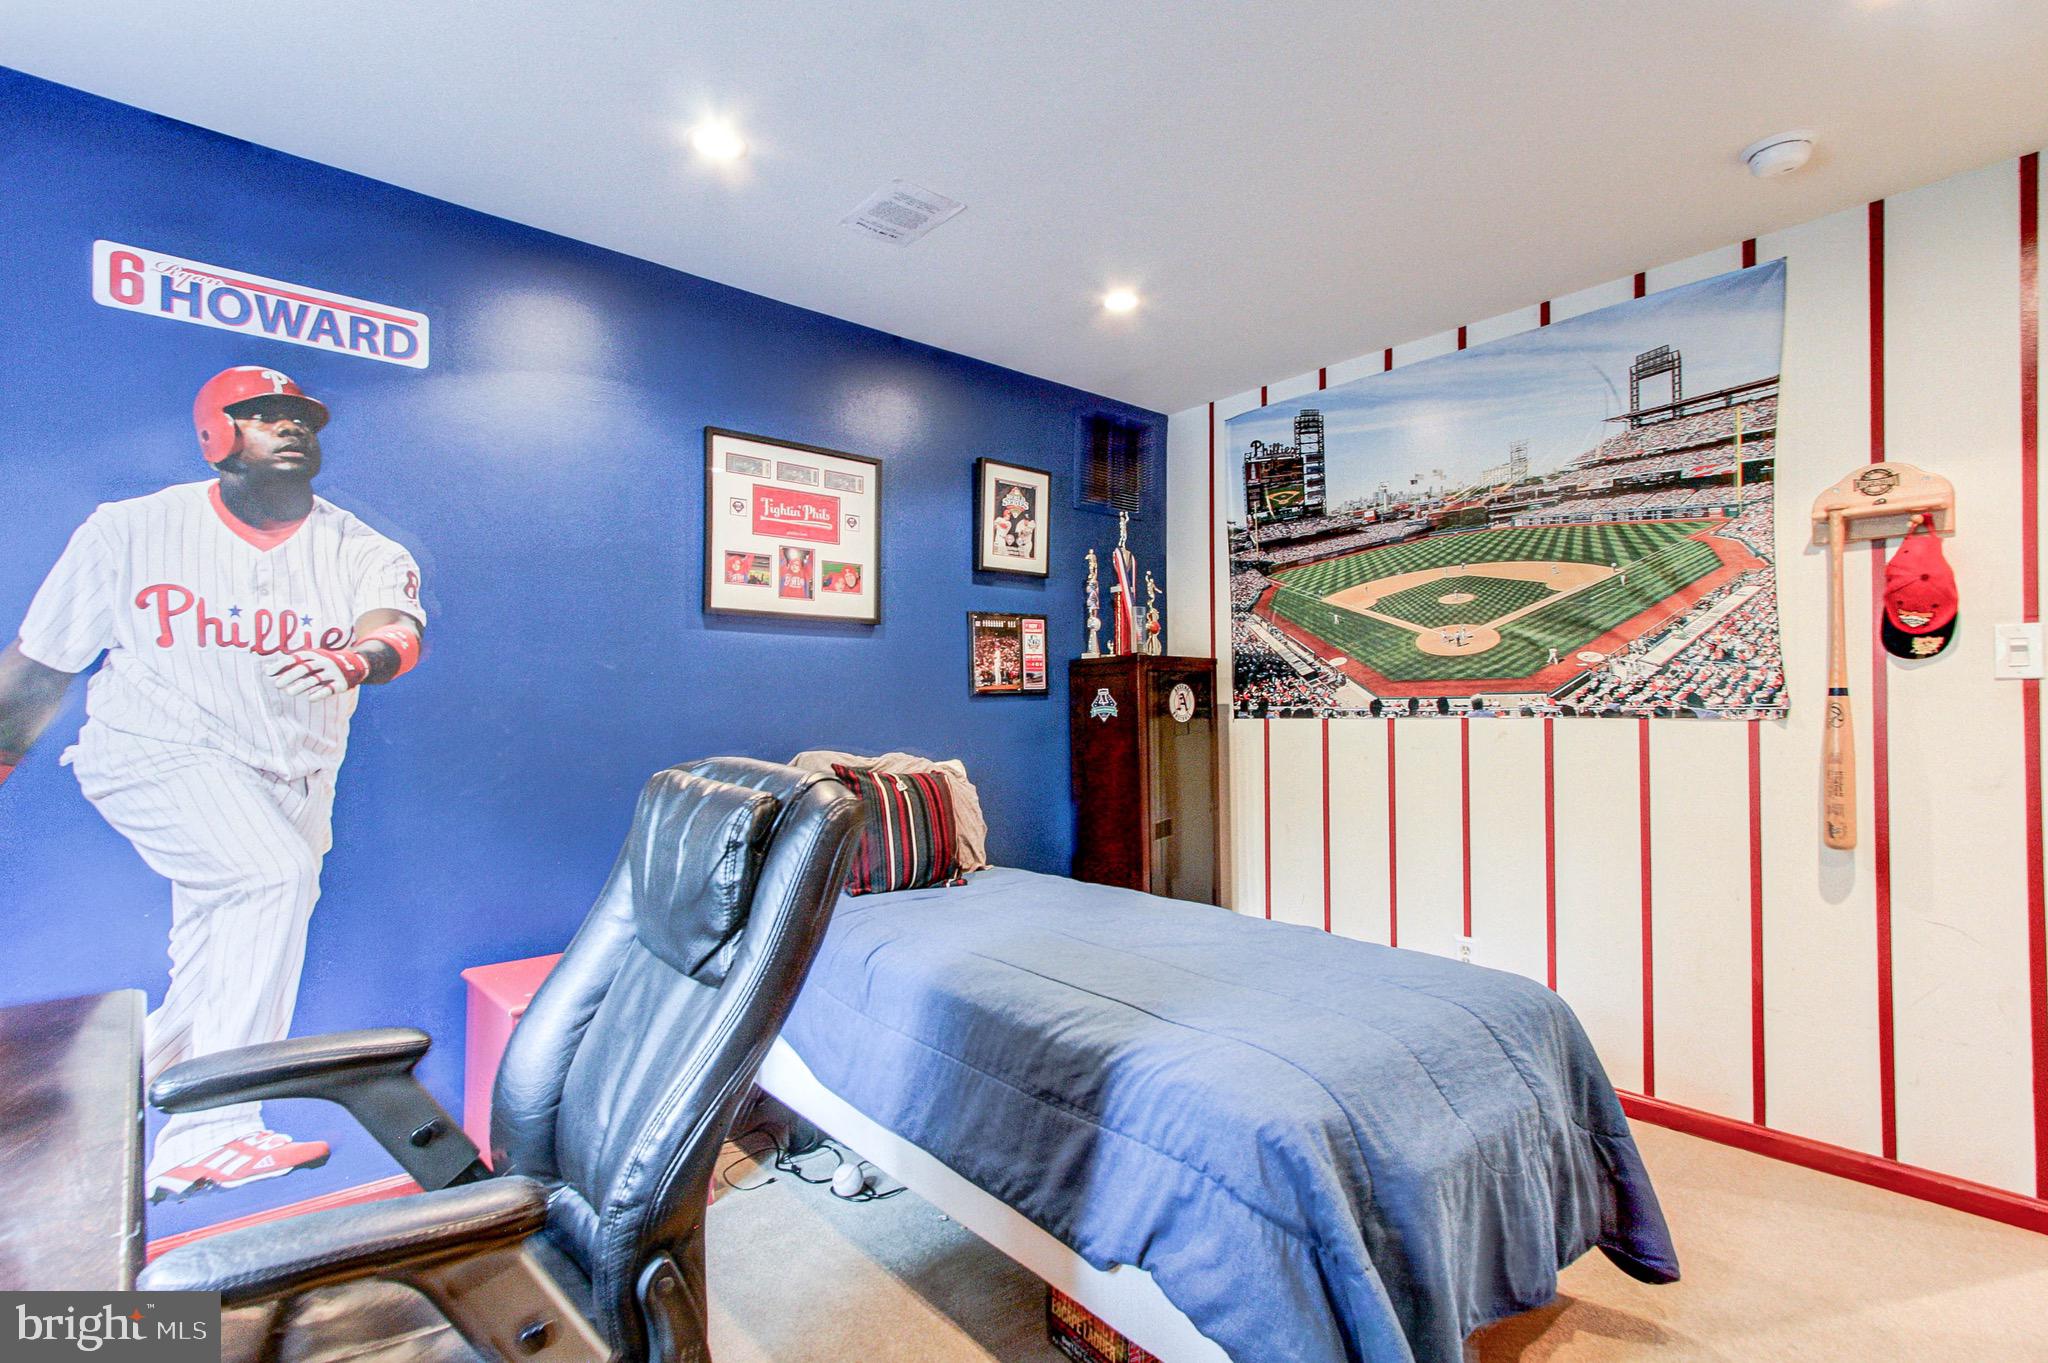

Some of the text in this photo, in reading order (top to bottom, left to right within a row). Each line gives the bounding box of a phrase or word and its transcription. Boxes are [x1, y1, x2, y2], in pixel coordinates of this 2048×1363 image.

[109, 250, 146, 306] 6
[160, 274, 419, 360] HOWARD
[134, 583, 354, 657] Phillie
